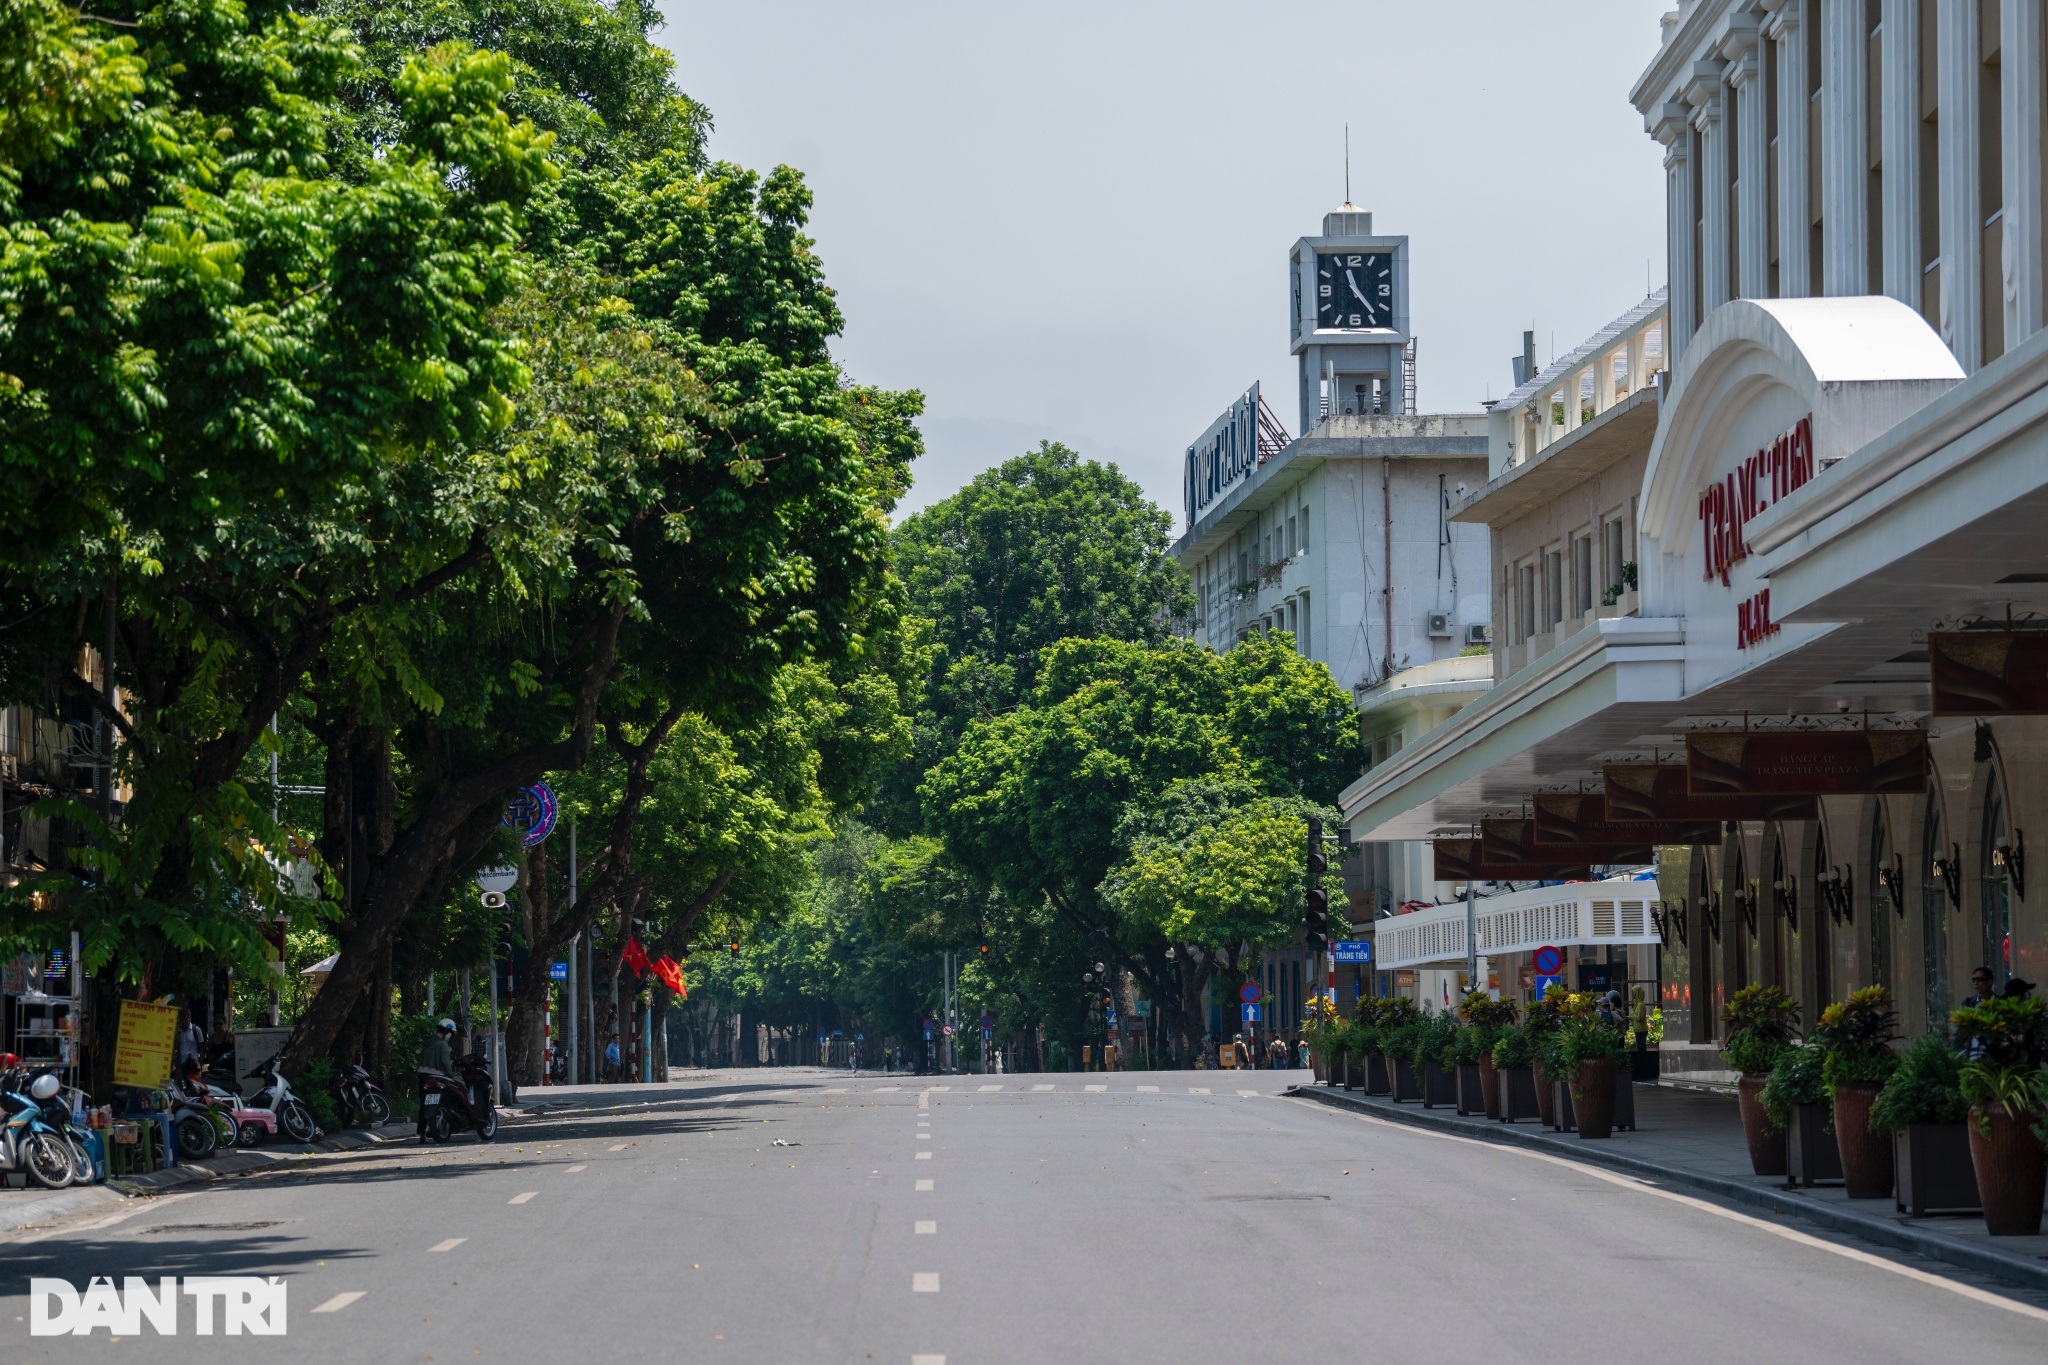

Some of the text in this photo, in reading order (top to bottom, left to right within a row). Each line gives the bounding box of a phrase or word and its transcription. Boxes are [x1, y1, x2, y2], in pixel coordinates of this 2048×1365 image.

[1347, 255, 1362, 268] 12
[1319, 284, 1332, 297] 9
[1378, 284, 1391, 297] 3
[1349, 314, 1362, 326] 6
[1736, 588, 1781, 651] PLAZ
